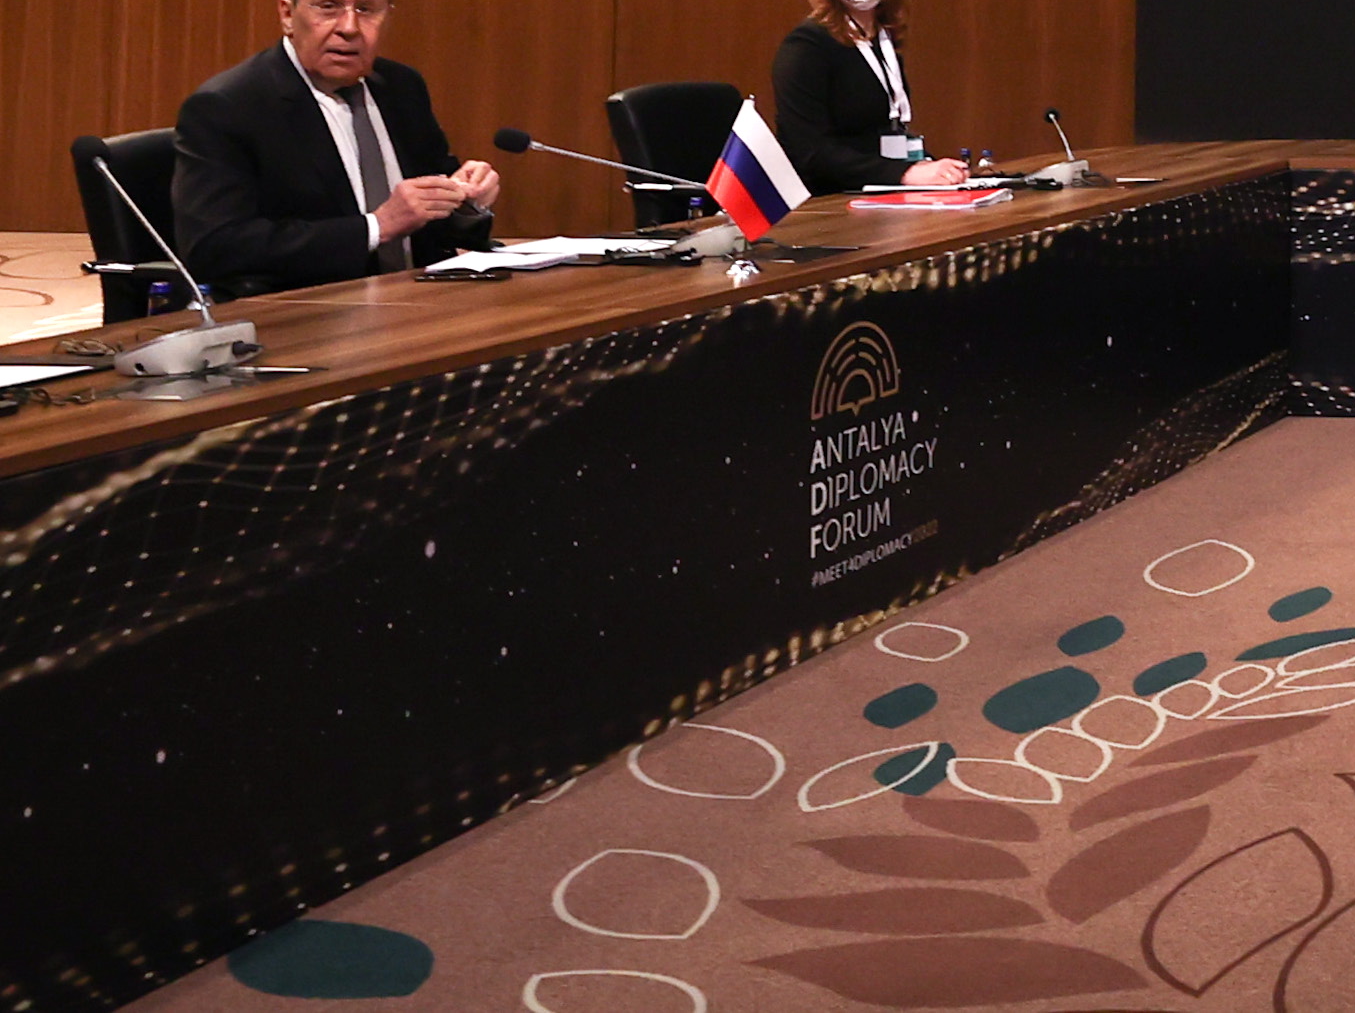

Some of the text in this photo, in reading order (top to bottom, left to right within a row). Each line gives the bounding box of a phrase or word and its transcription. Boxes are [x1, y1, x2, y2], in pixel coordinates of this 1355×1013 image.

[809, 412, 906, 474] ANTALYA
[811, 438, 937, 516] DIPLOMACY
[810, 497, 891, 559] FORUM
